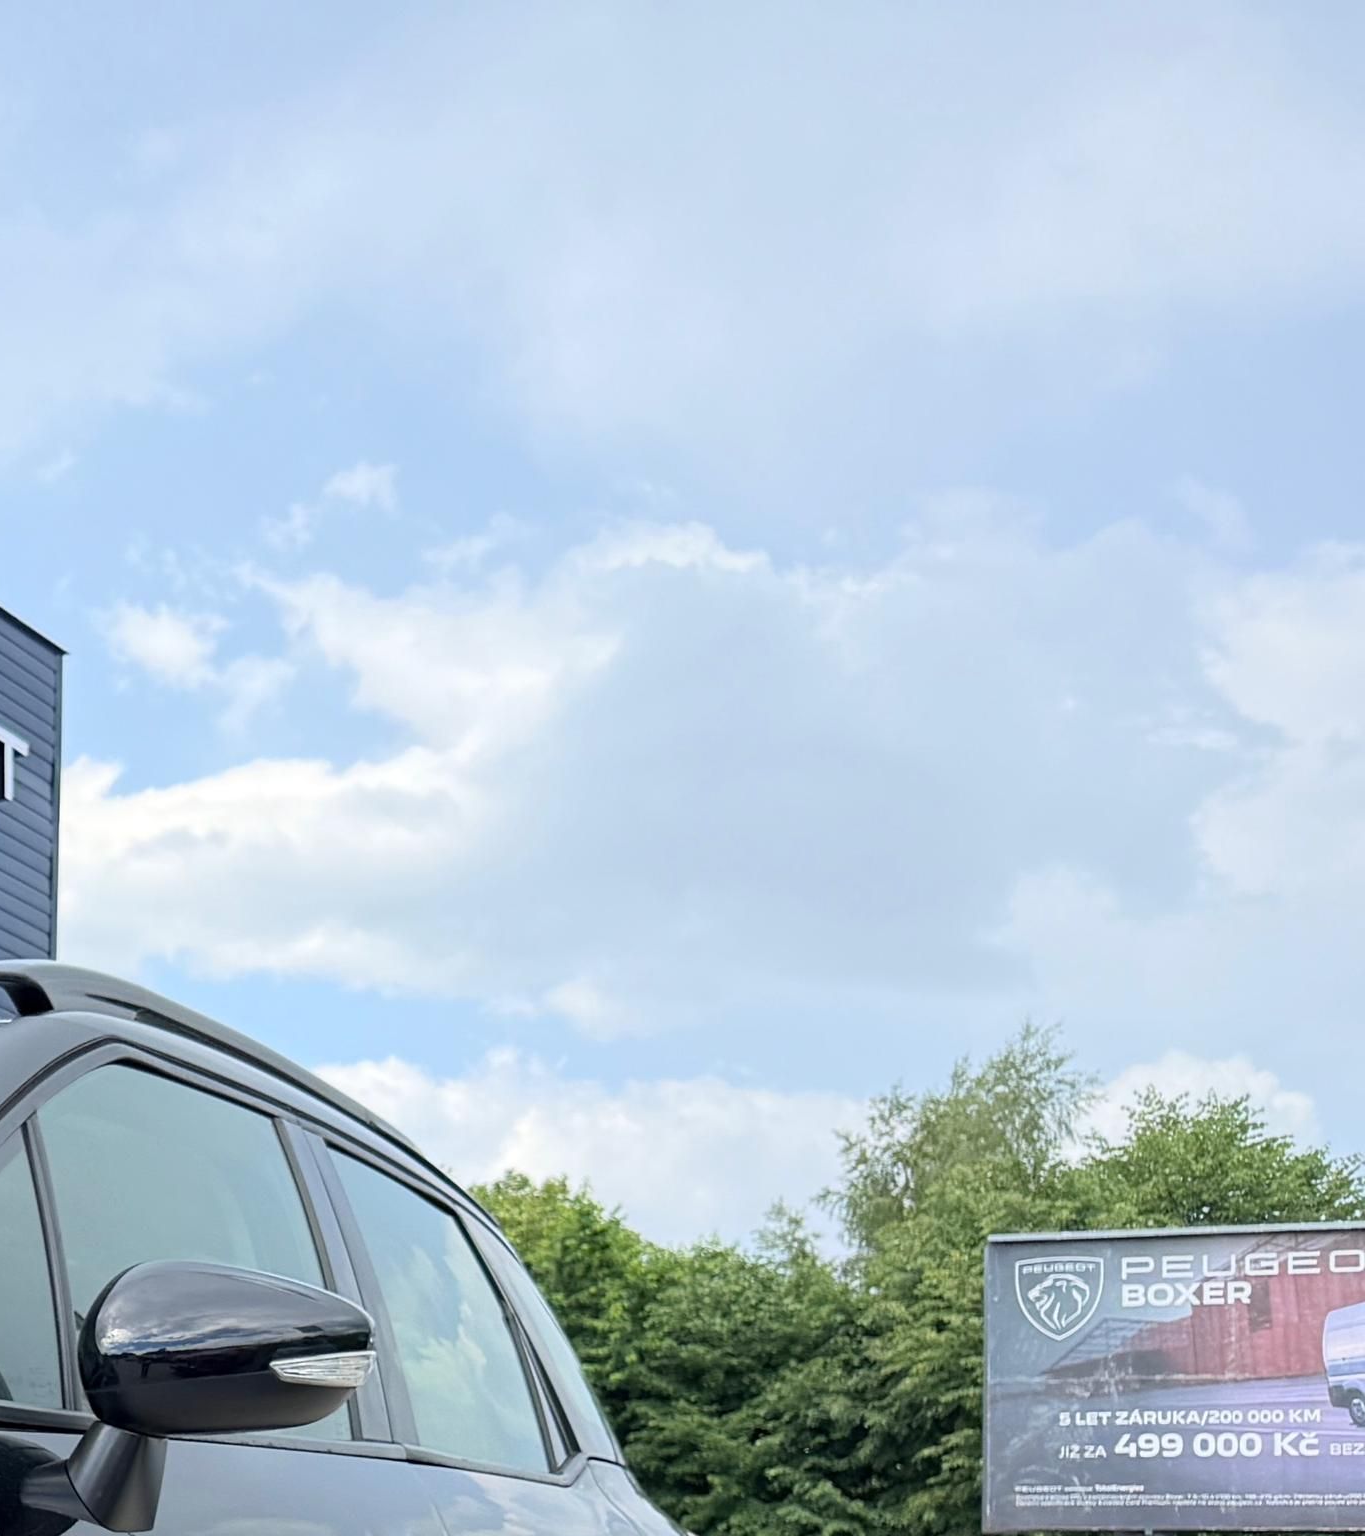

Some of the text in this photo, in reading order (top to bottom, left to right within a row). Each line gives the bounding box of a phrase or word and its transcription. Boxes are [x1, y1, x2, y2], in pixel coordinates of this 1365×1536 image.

[1021, 1262, 1097, 1276] PEUGEOT
[1121, 1280, 1253, 1308] BOXER
[1075, 1411, 1112, 1427] LET
[1115, 1407, 1244, 1427] ZÁRUKA/200
[1247, 1408, 1285, 1424] 000
[1288, 1407, 1322, 1424] KM
[1084, 1445, 1108, 1459] ZA
[1114, 1433, 1184, 1459] 499
[1192, 1432, 1263, 1458] 000
[1273, 1430, 1321, 1457] Kč
[1330, 1441, 1365, 1457] BEZ
